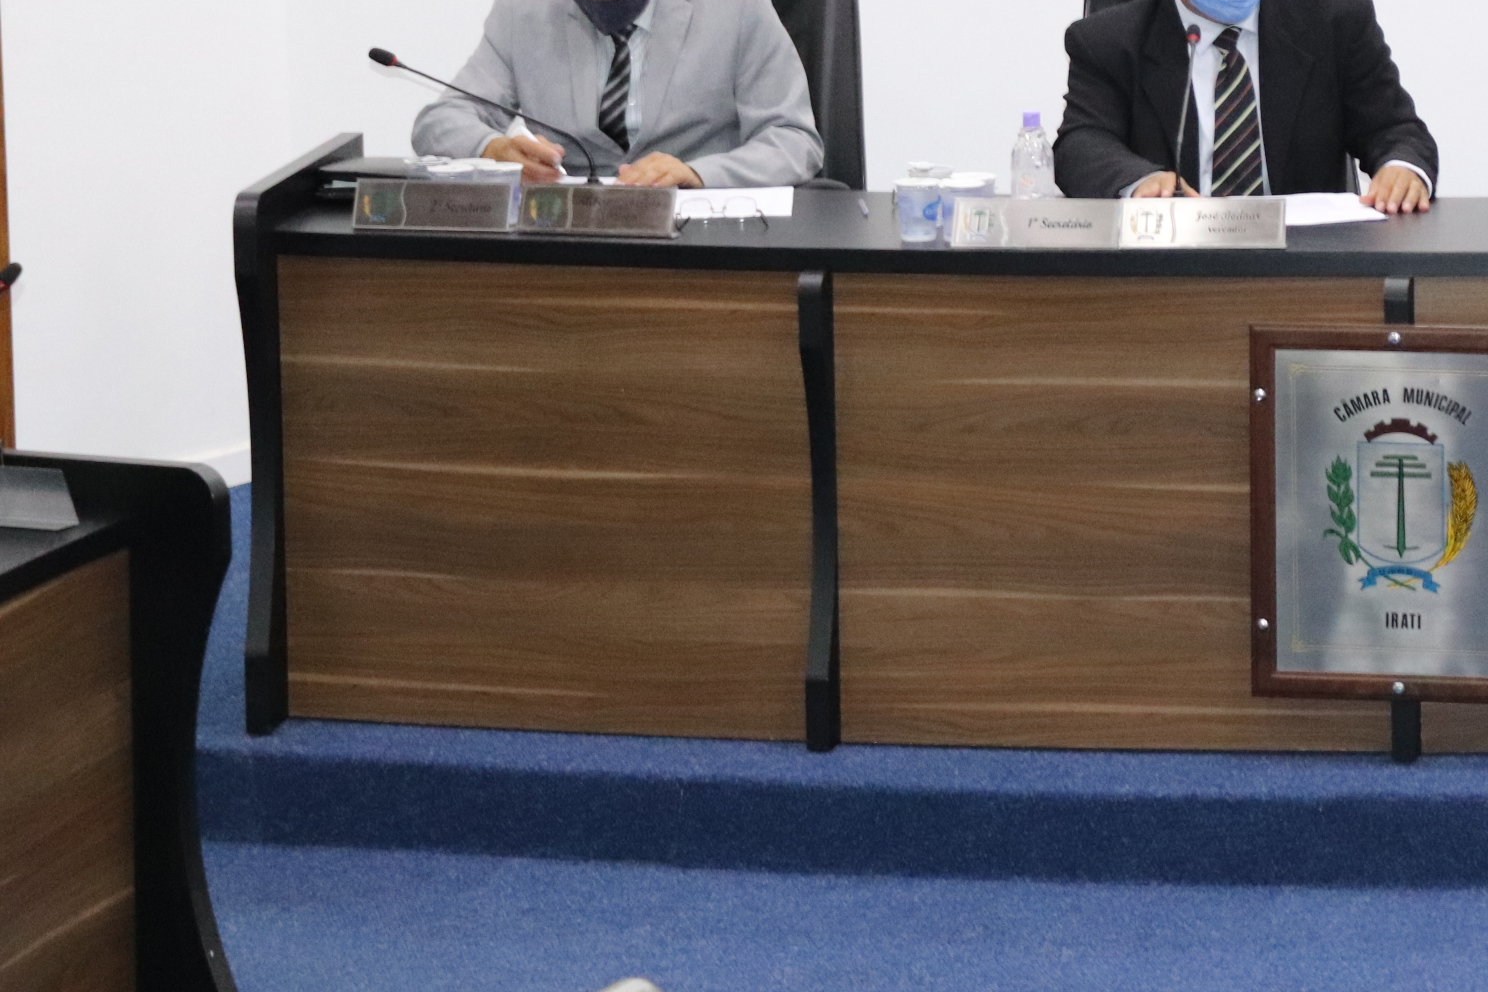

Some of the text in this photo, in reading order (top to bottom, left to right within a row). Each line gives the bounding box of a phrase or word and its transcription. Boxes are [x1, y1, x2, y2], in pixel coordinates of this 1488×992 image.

[1333, 387, 1473, 426] CÂMARA MUNICIPAL
[1384, 611, 1422, 630] IRATI
